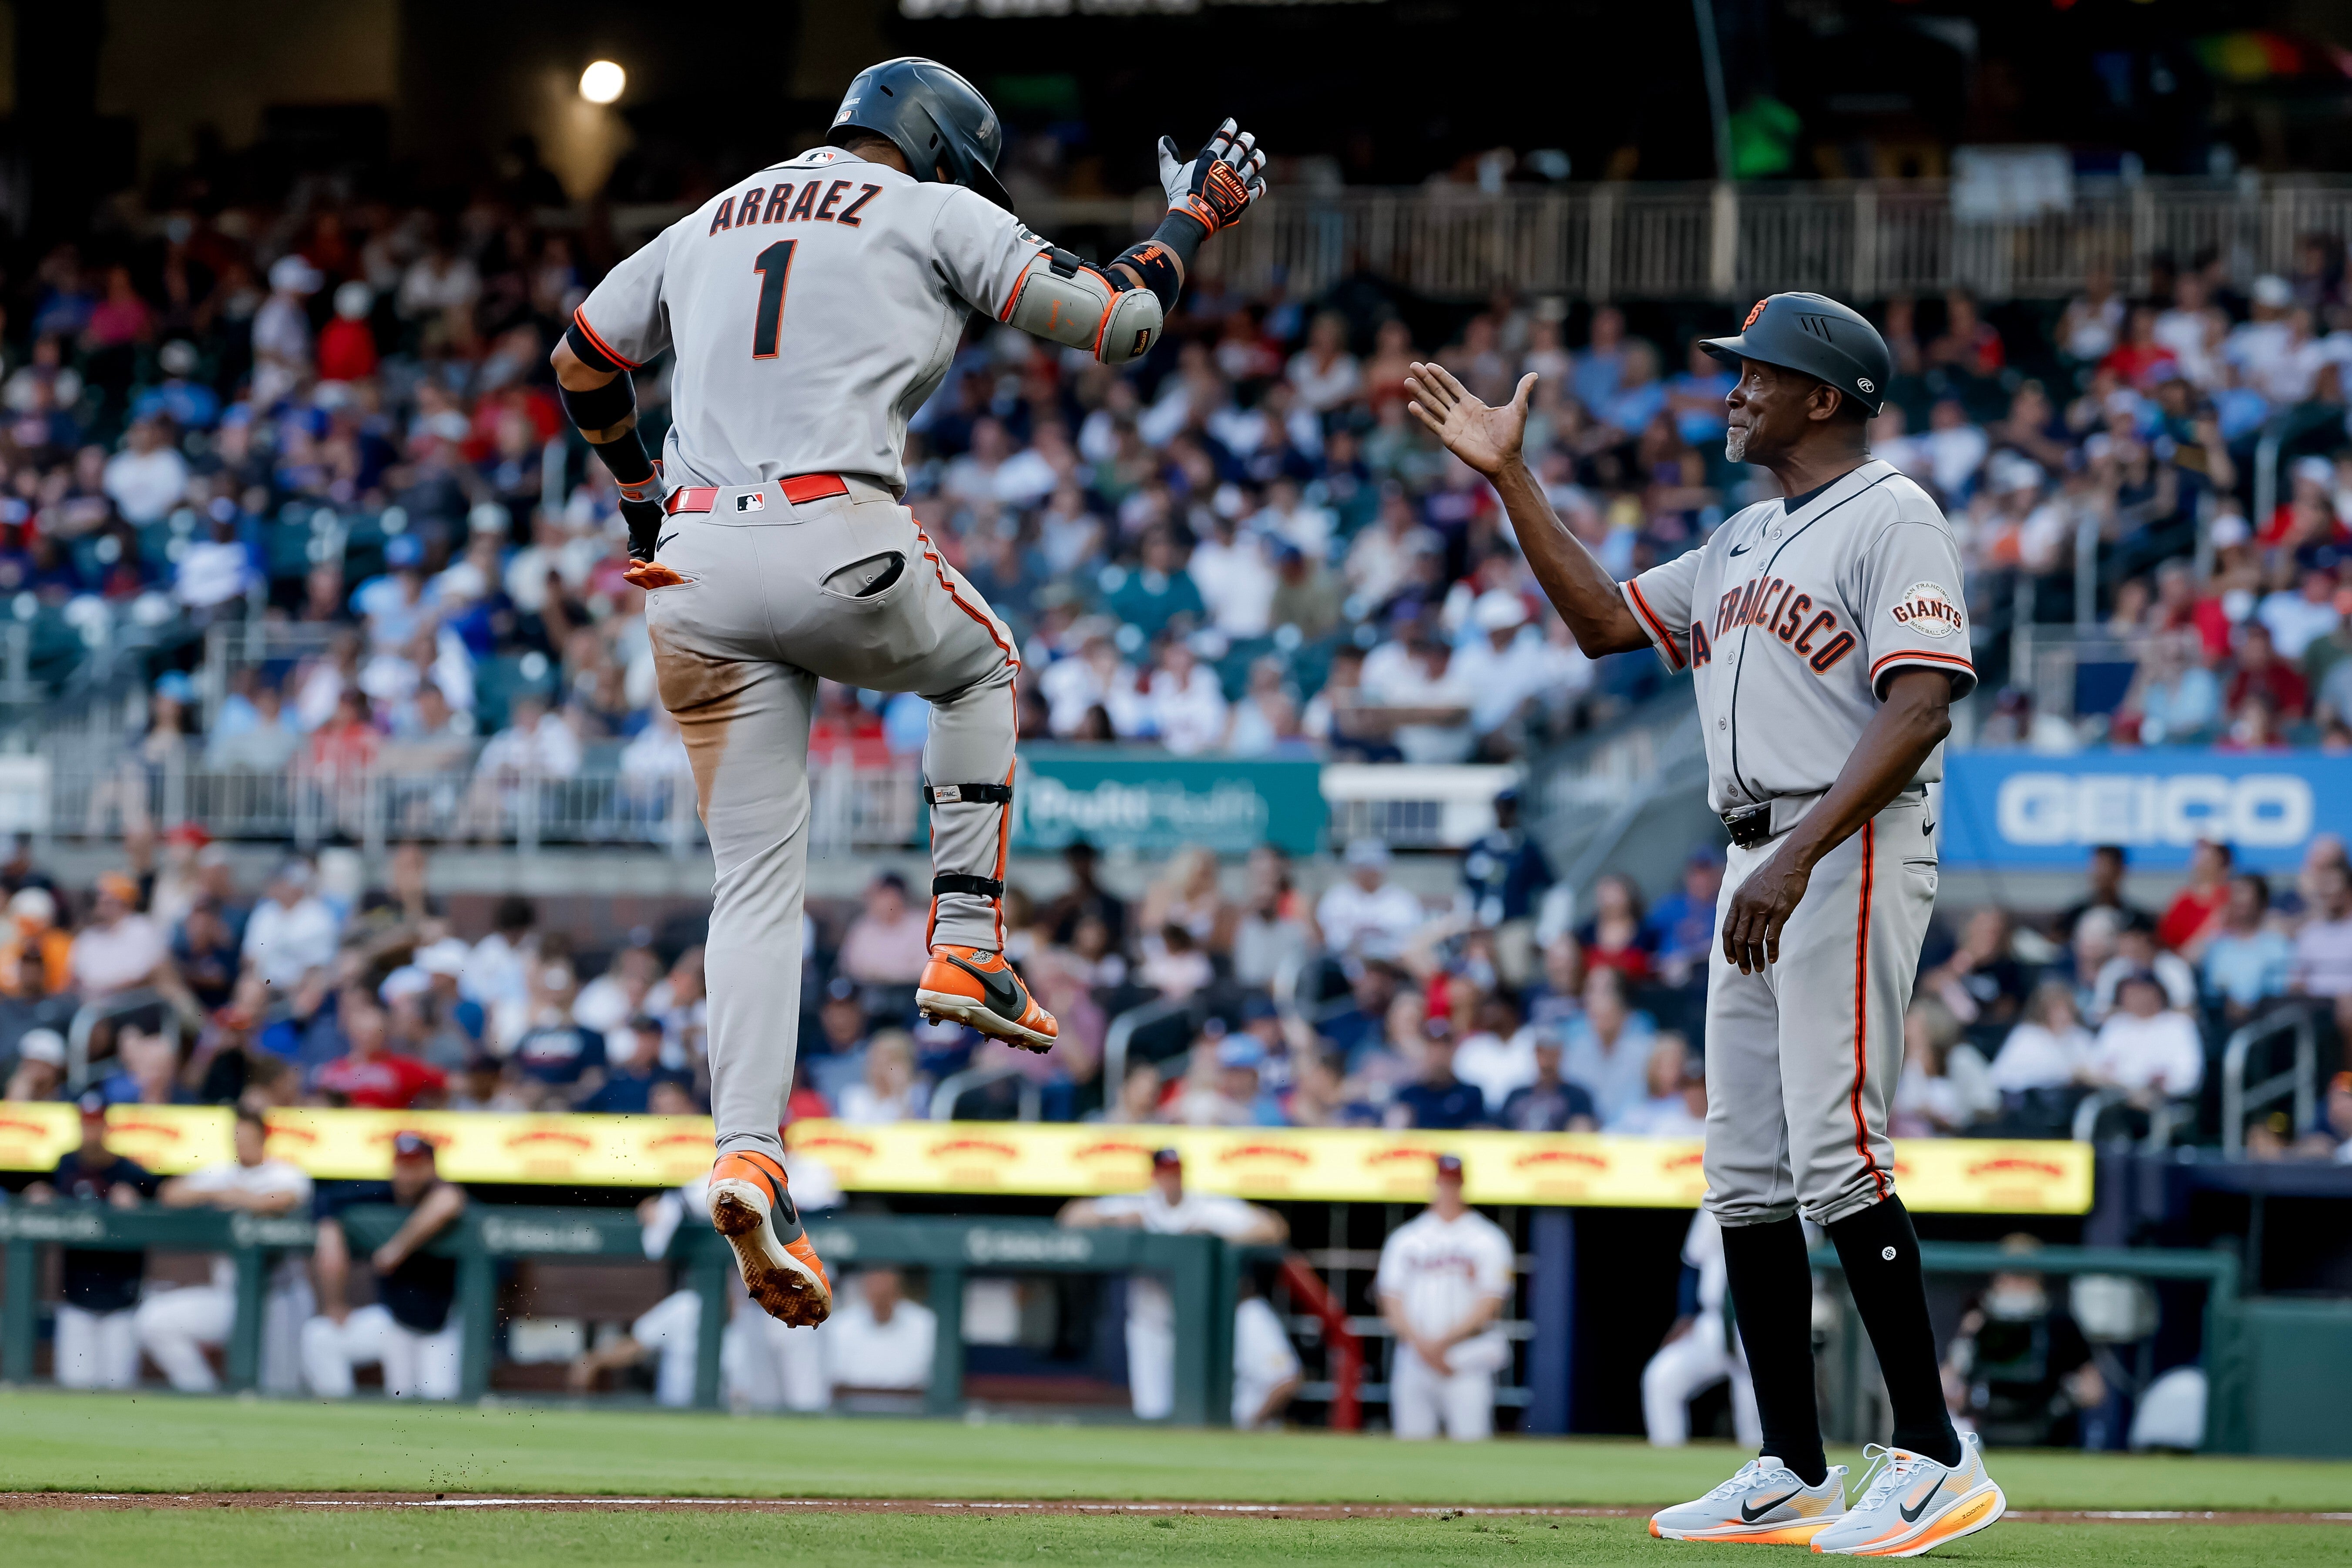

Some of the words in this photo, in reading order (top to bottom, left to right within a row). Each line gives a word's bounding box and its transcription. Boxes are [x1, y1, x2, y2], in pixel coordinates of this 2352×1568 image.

[1212, 165, 1245, 198] Franklin
[709, 180, 883, 237] ARRAEZ
[1156, 259, 1164, 269] 1
[752, 239, 798, 360] 1
[1904, 588, 1916, 600] SAN
[1916, 583, 1951, 604] FRANCISCO
[1714, 575, 1856, 675] FRANCISCO
[1892, 600, 1963, 629] GIANTS
[1910, 621, 1941, 635] BASEBALL
[1941, 624, 1952, 635] CLUB
[1996, 772, 2314, 846] GEICO
